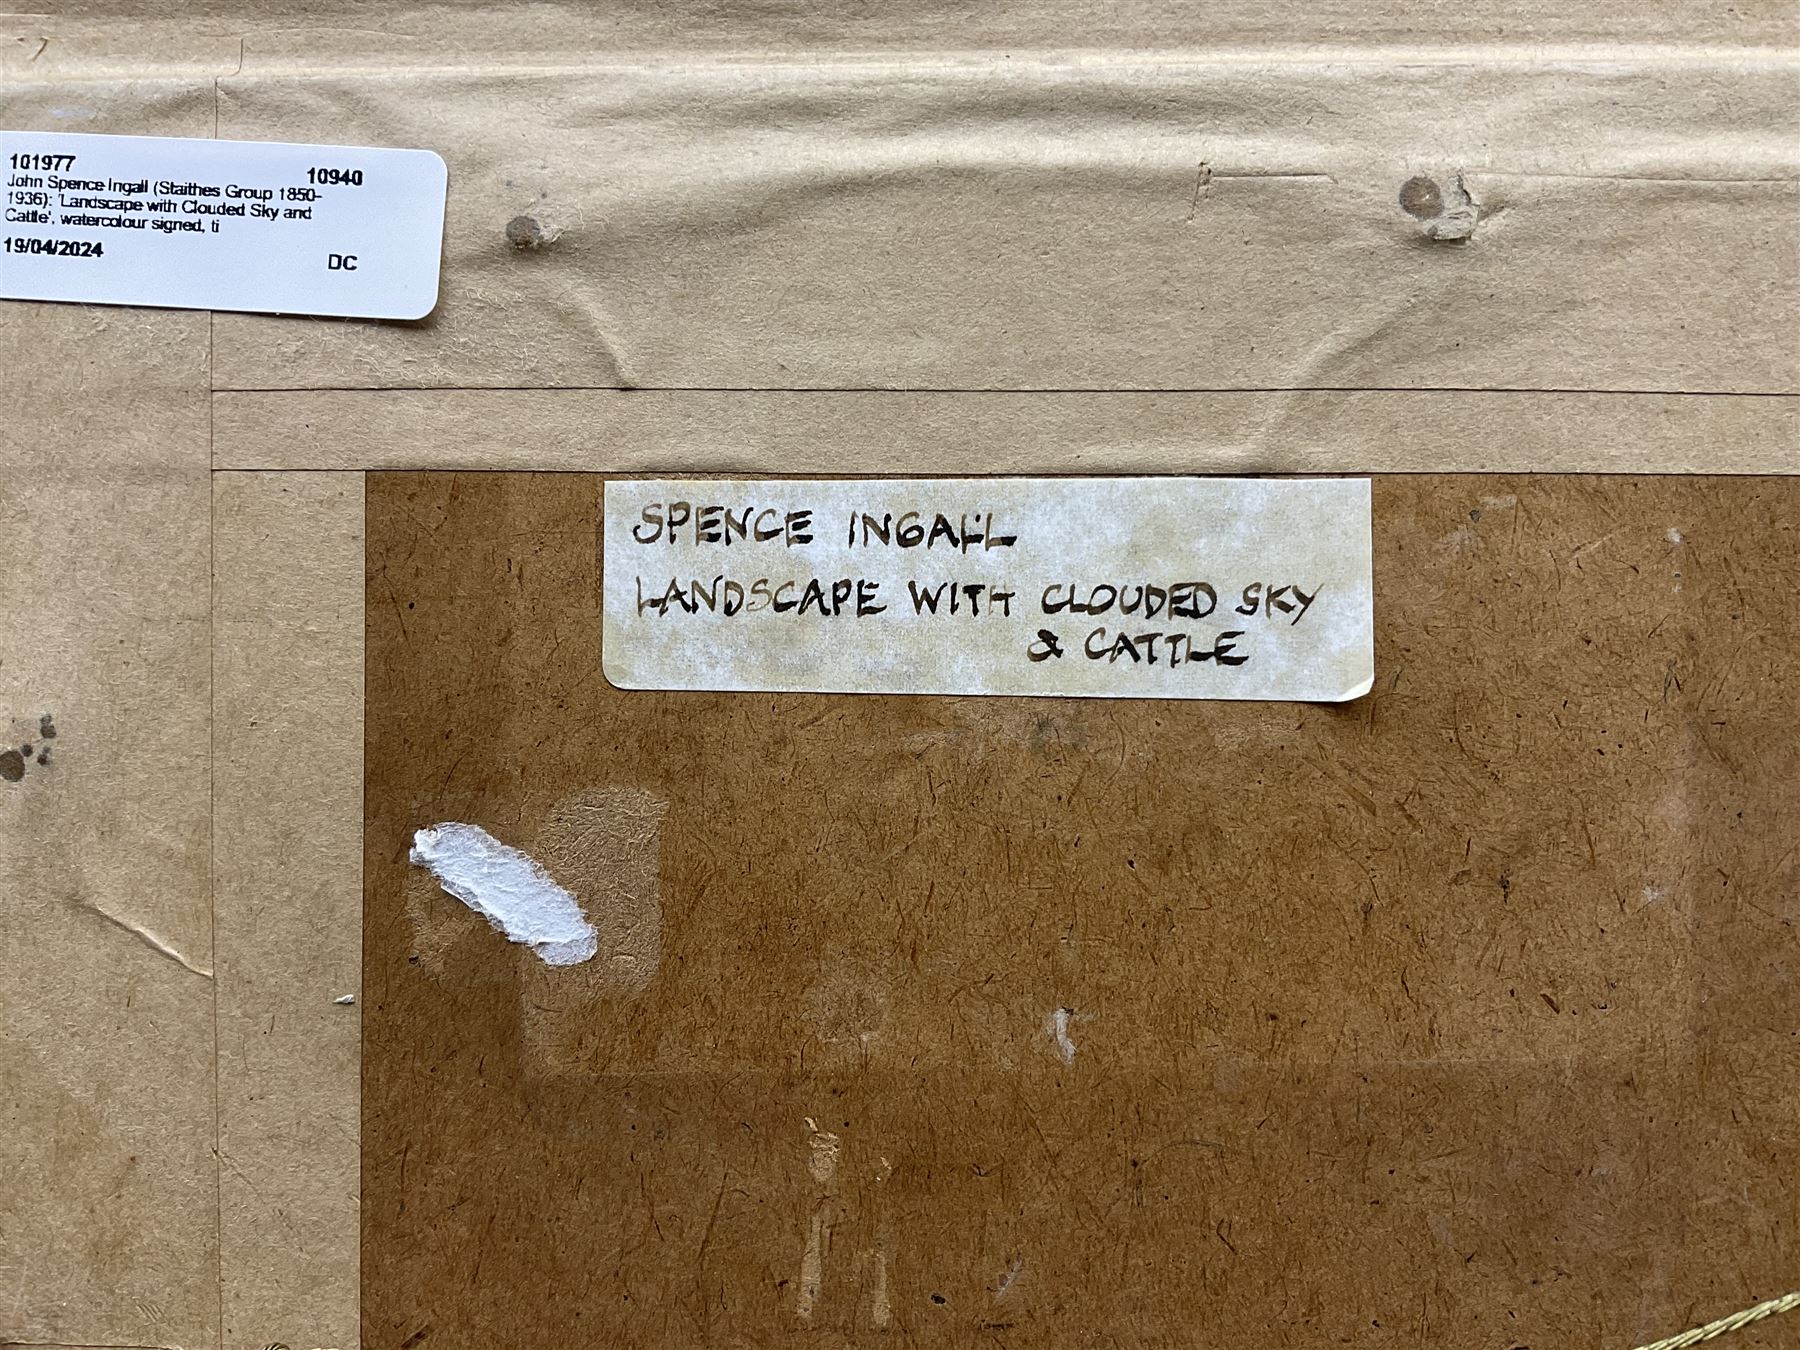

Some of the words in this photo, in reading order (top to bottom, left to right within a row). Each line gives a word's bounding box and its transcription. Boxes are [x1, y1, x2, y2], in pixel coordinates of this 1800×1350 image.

[9, 153, 77, 172] 101977
[306, 167, 363, 187] 10940
[7, 173, 43, 189] John
[48, 176, 105, 195] Spence
[108, 179, 149, 197] Ingall
[153, 181, 221, 199] (Staithes
[225, 184, 273, 203] Group
[279, 186, 323, 203] 1850-
[7, 191, 53, 211] 1936):
[146, 199, 178, 213] with
[181, 200, 245, 217] Clouded
[250, 203, 280, 222] Sky
[283, 206, 313, 221] and
[60, 213, 149, 231] watercolour
[151, 218, 206, 235] signed,
[211, 219, 220, 234] ti
[3, 237, 104, 258] 19/04/2024
[327, 254, 358, 271] DC
[633, 502, 813, 549] SPENCE
[637, 574, 887, 619] LANDSCAPE
[908, 580, 1016, 620] WITH
[1041, 582, 1217, 622] CLOUDED
[1234, 582, 1323, 627] SKY
[1027, 628, 1064, 663] &
[1084, 627, 1249, 669] CATTLE
